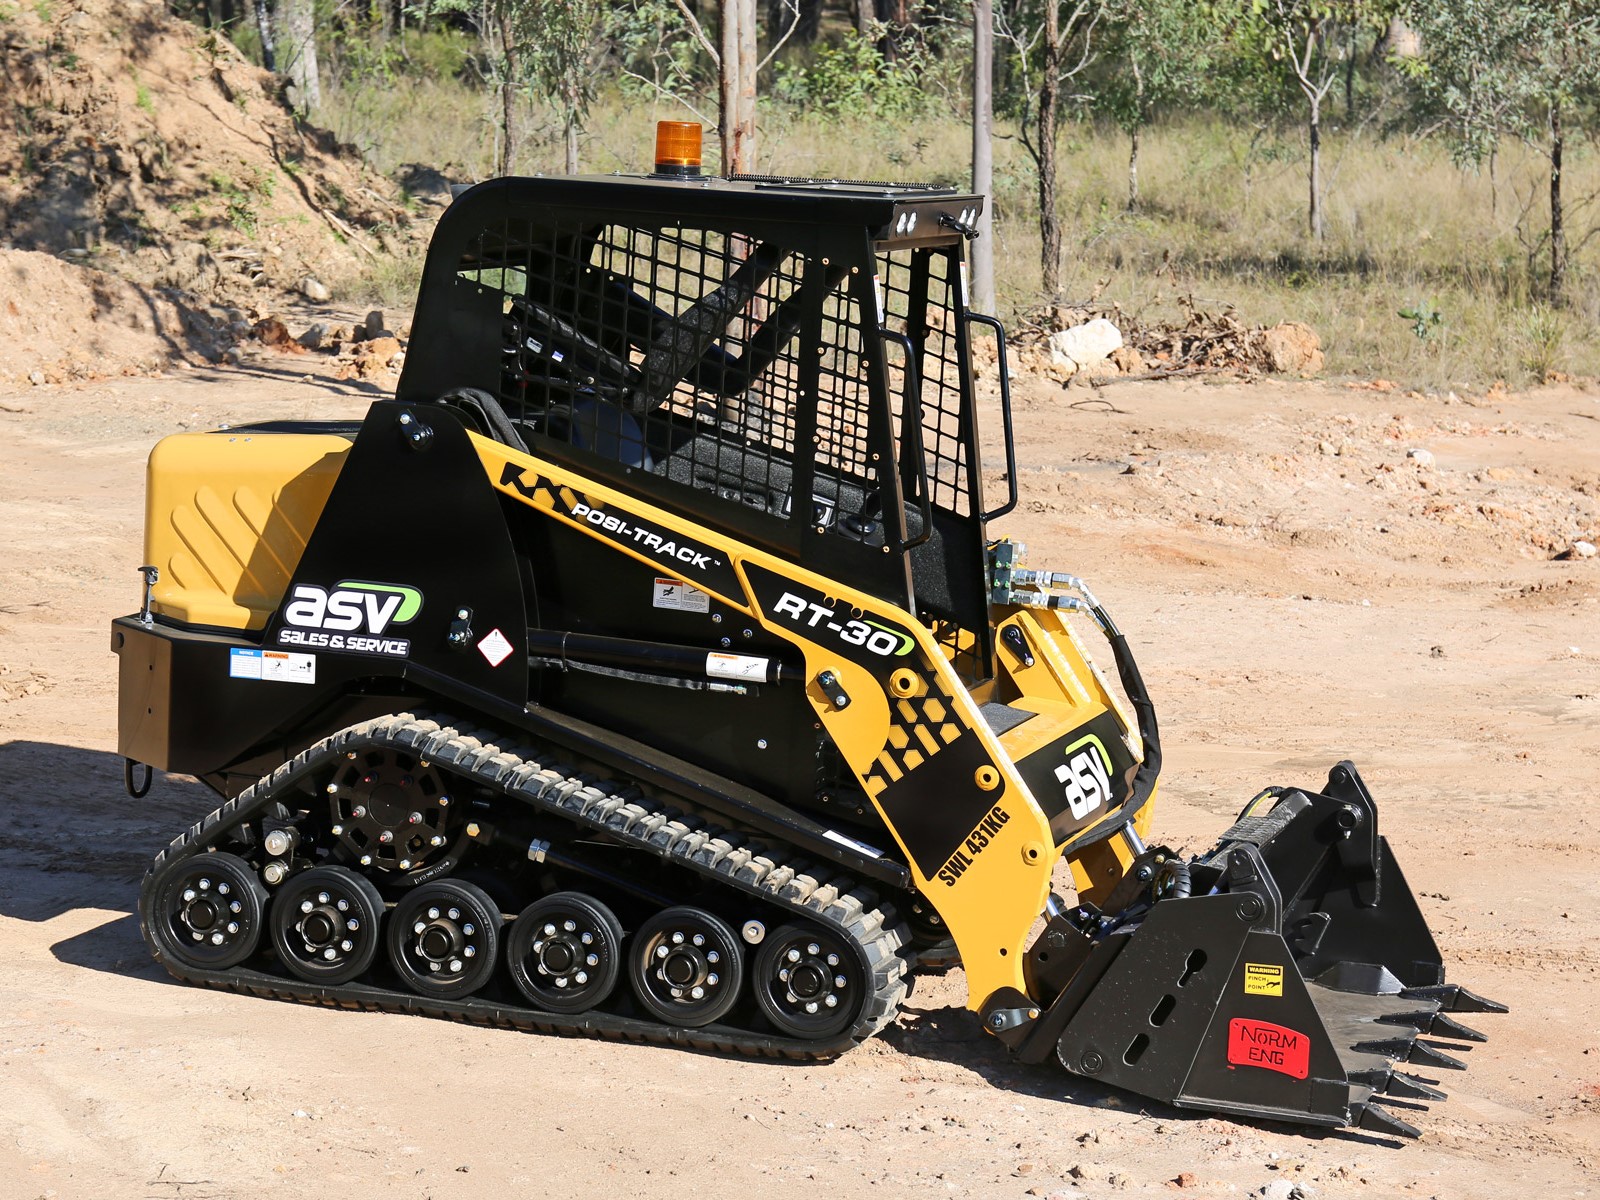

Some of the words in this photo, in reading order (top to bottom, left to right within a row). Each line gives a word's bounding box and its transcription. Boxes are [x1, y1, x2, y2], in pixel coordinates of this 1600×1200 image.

[571, 503, 711, 570] POSI-TRACK
[773, 592, 898, 656] RT-30
[329, 634, 345, 649] &
[346, 636, 408, 655] SERVICE
[937, 850, 974, 887] SWL
[965, 806, 1010, 855] 431KG
[1249, 966, 1280, 975] WARNING
[1241, 1025, 1297, 1050] NORM
[1249, 1047, 1284, 1066] ENG
